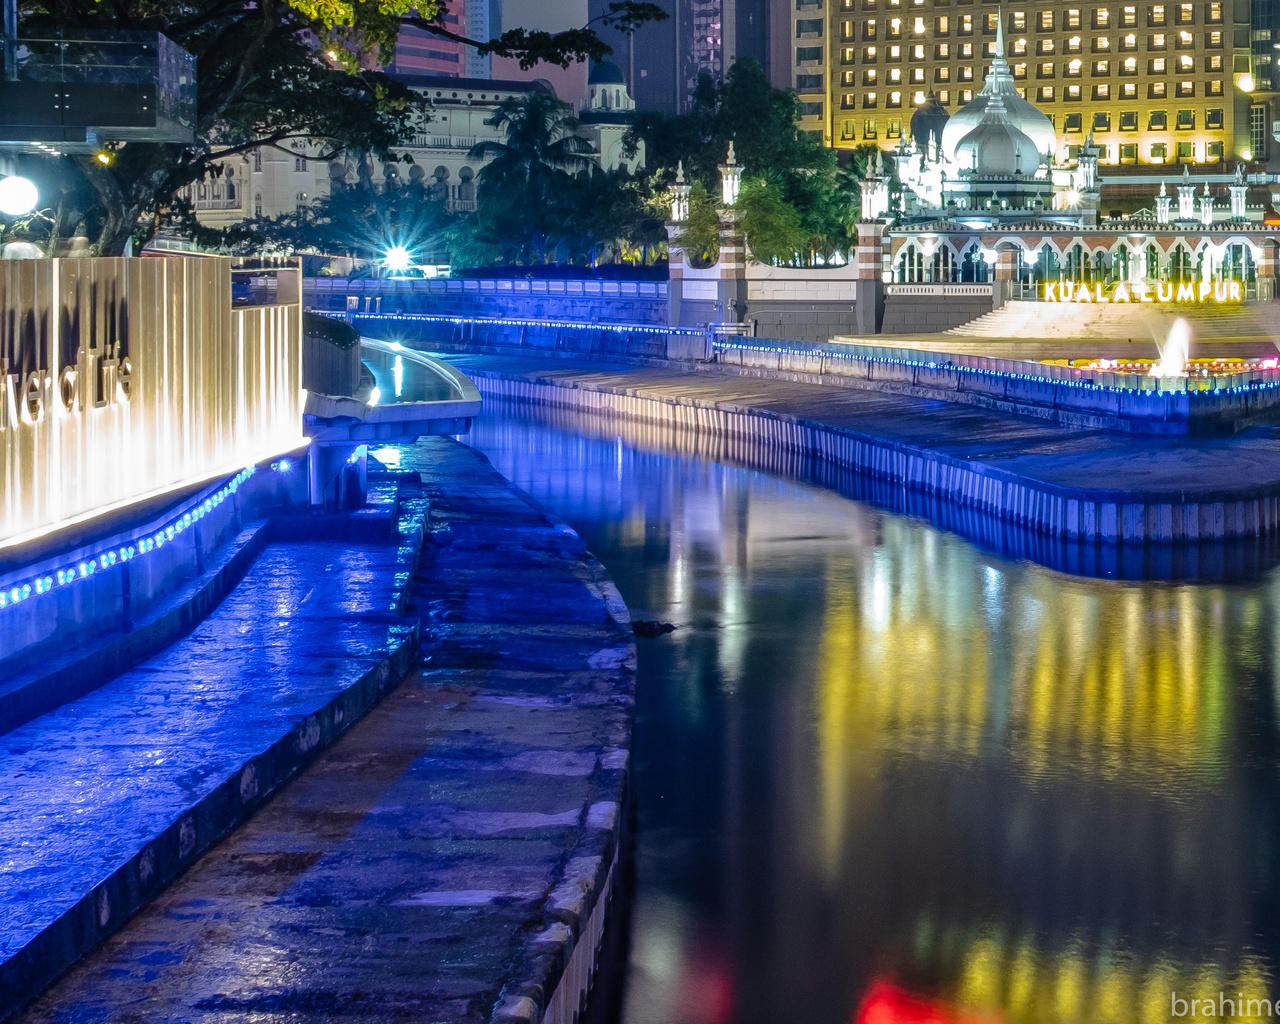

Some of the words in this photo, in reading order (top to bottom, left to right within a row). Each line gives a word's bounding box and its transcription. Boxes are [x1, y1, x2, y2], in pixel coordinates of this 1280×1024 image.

[1044, 280, 1130, 302] KUALA
[1139, 281, 1241, 302] LUMPUR
[60, 345, 86, 413] of
